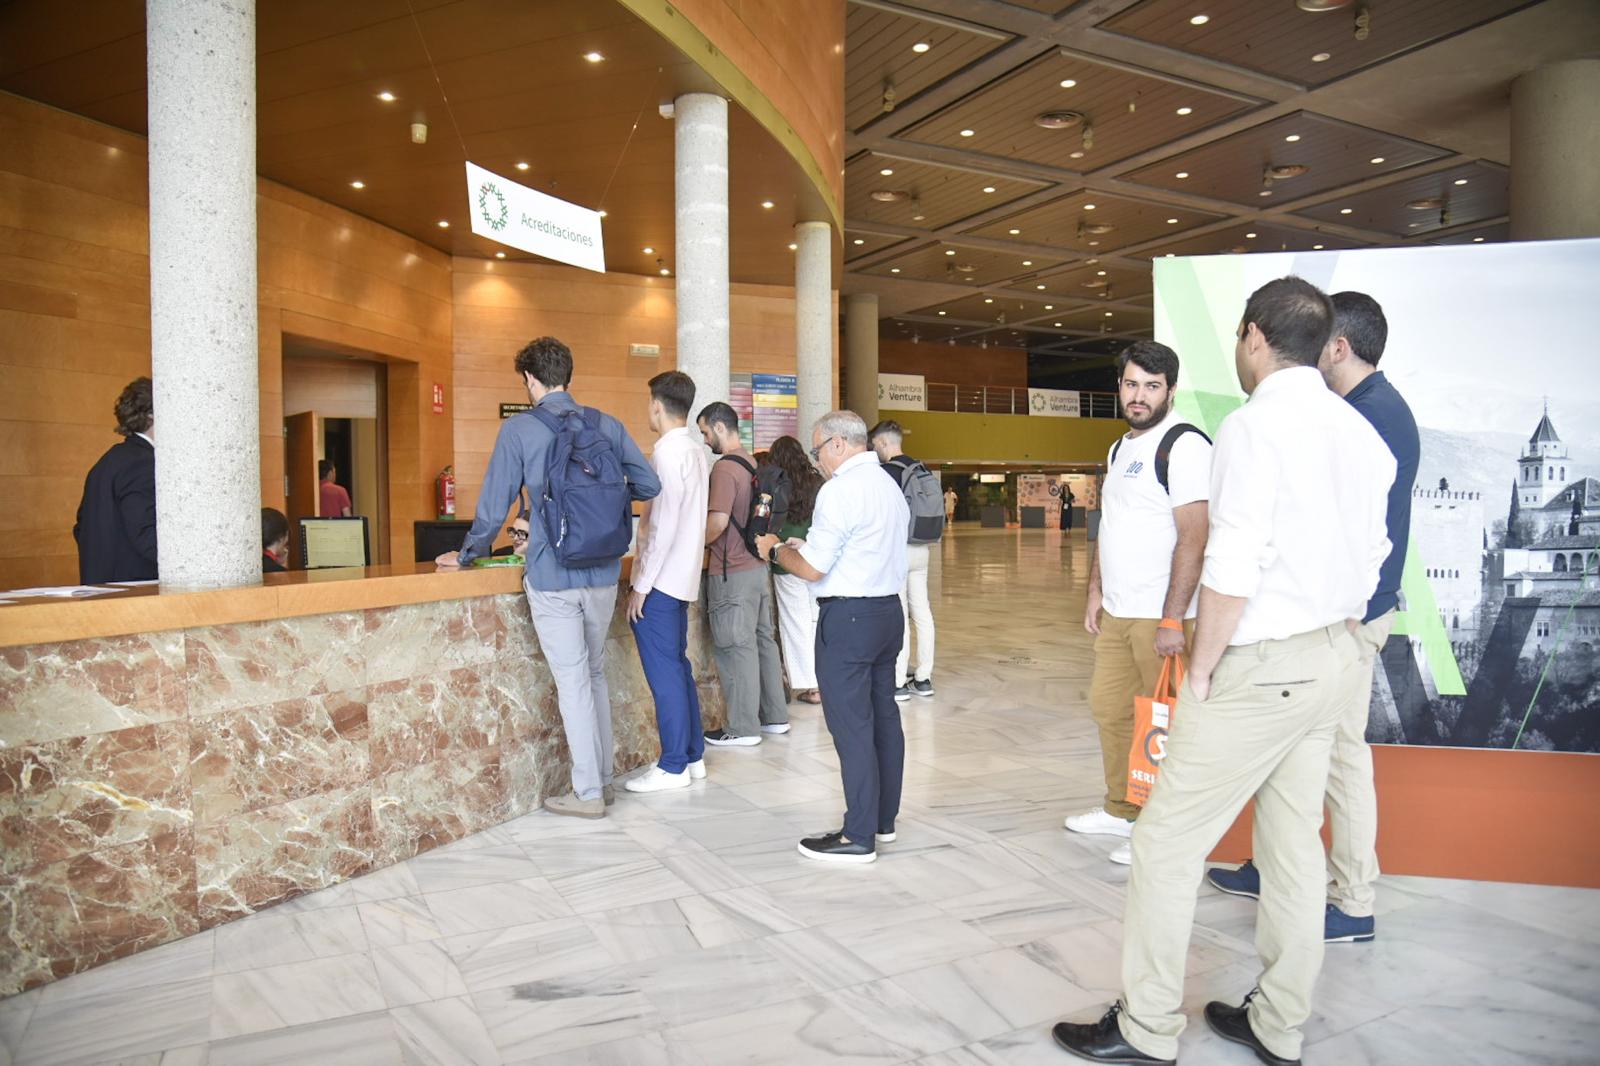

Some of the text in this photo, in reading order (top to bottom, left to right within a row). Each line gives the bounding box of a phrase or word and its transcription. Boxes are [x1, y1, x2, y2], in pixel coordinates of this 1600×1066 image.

[521, 213, 593, 247] Acreditaciones
[889, 384, 922, 393] Alhambra
[889, 392, 922, 402] Venture
[1050, 402, 1078, 412] Venture
